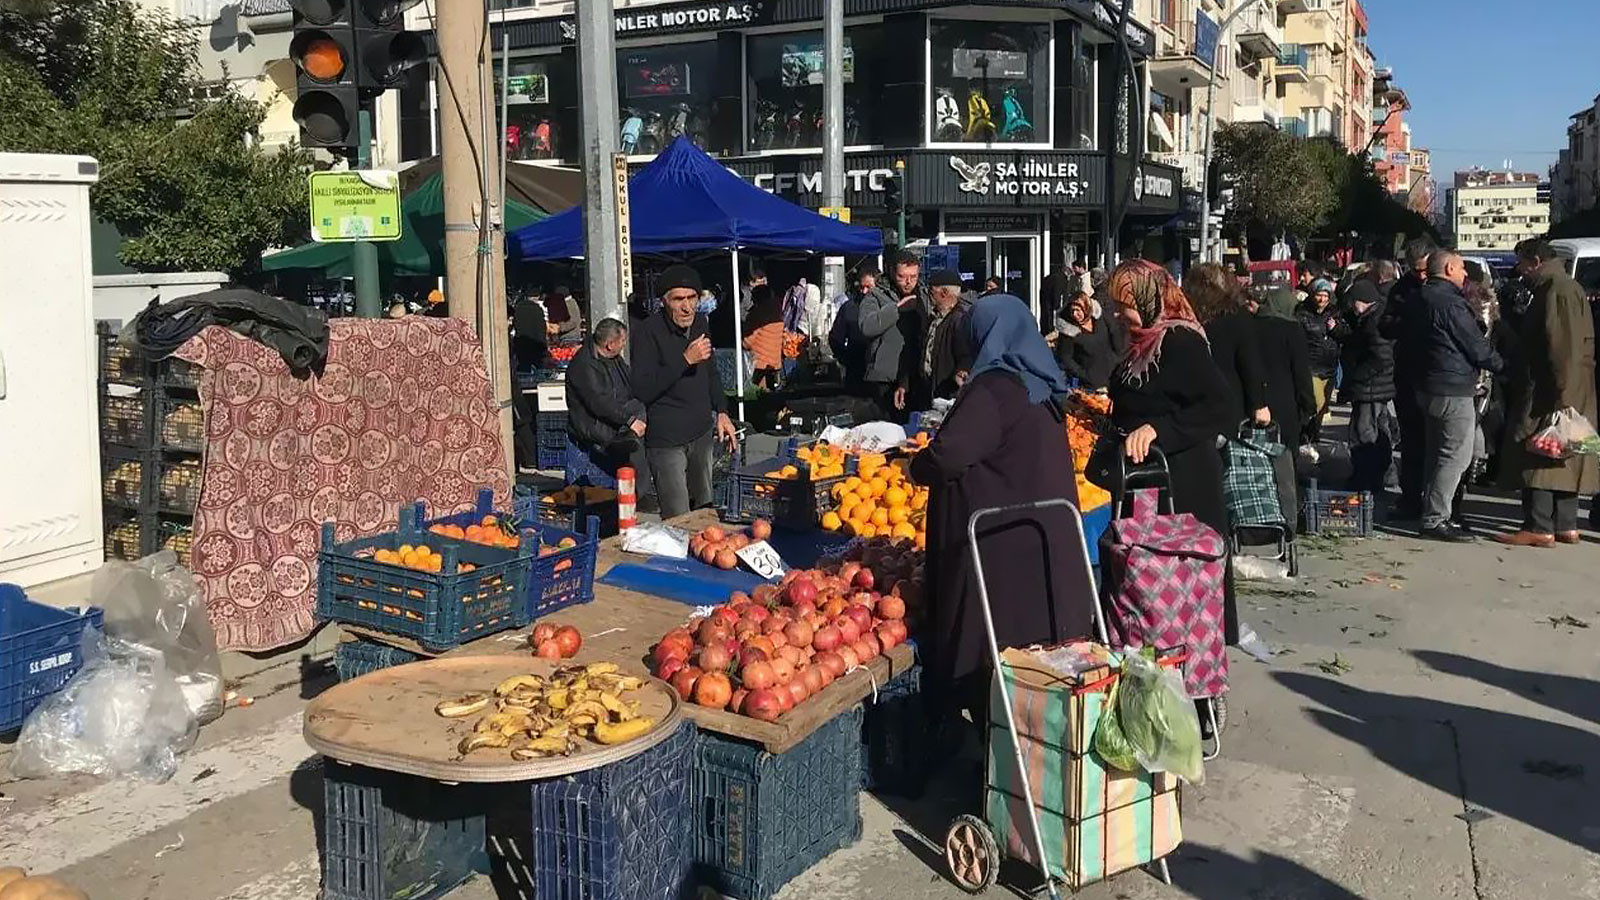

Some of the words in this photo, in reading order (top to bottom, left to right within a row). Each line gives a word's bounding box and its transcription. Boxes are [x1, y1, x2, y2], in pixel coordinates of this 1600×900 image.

[615, 15, 658, 31] NLER
[662, 8, 721, 26] MOTOR
[995, 158, 1078, 180] ŞAHİNLER
[754, 168, 893, 194] CFMTO
[995, 181, 1050, 195] MOTOR
[618, 174, 626, 215] OKUL
[753, 553, 780, 576] 30
